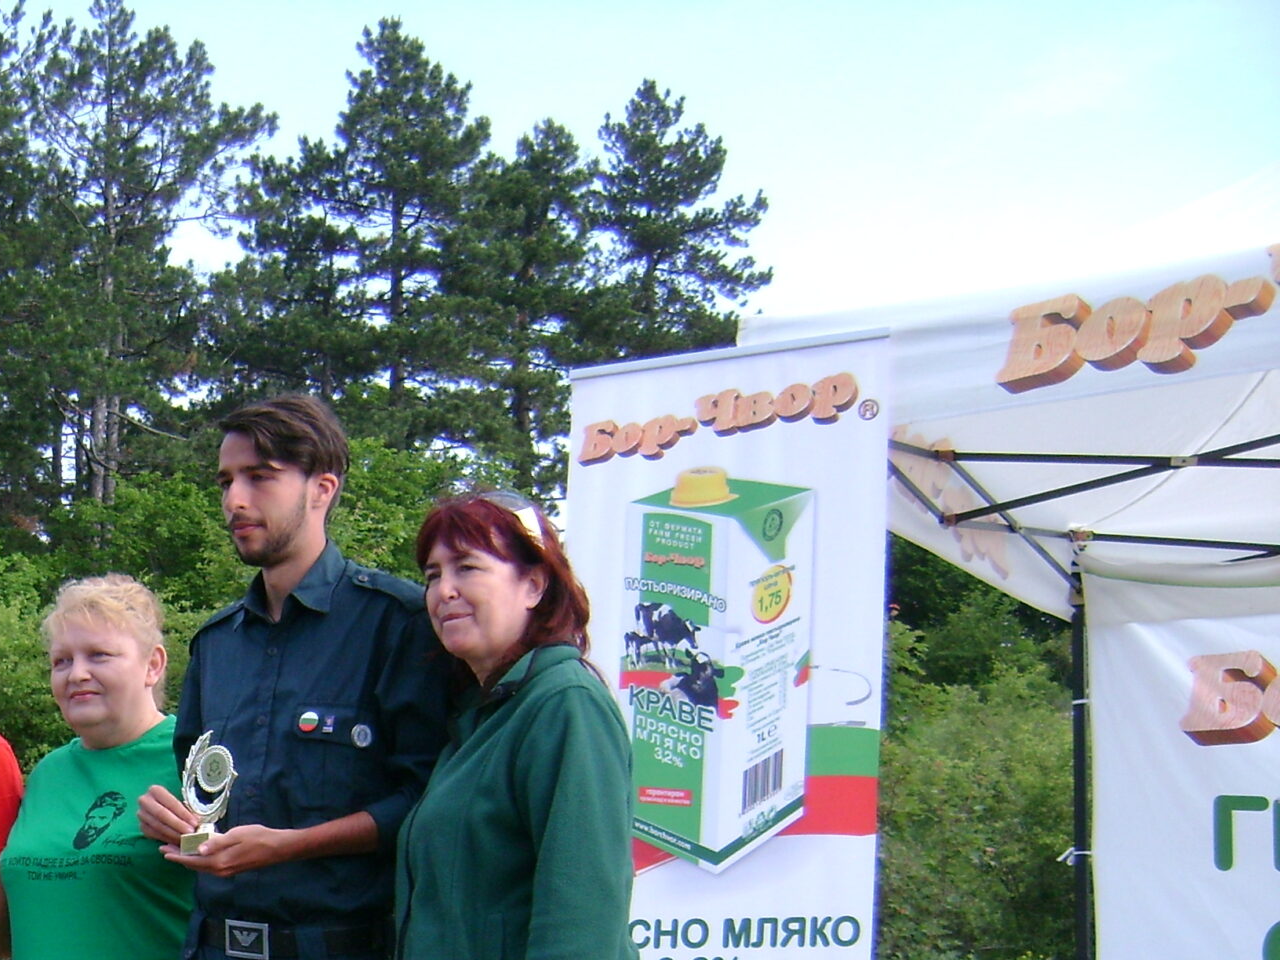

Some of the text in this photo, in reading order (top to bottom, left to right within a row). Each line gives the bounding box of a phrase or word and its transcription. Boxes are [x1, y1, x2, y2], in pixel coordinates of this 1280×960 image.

[996, 243, 1280, 394] Бор-
[624, 577, 727, 613] ПАСТЬОРИЗИРАНО
[757, 589, 782, 613] 1,75
[628, 684, 715, 733] КРАВЕ
[1180, 650, 1280, 747] Б
[636, 715, 702, 746] ПРЯСНО
[636, 728, 701, 760] МЛЯКО
[628, 916, 861, 949] СНО МЛЯКО
